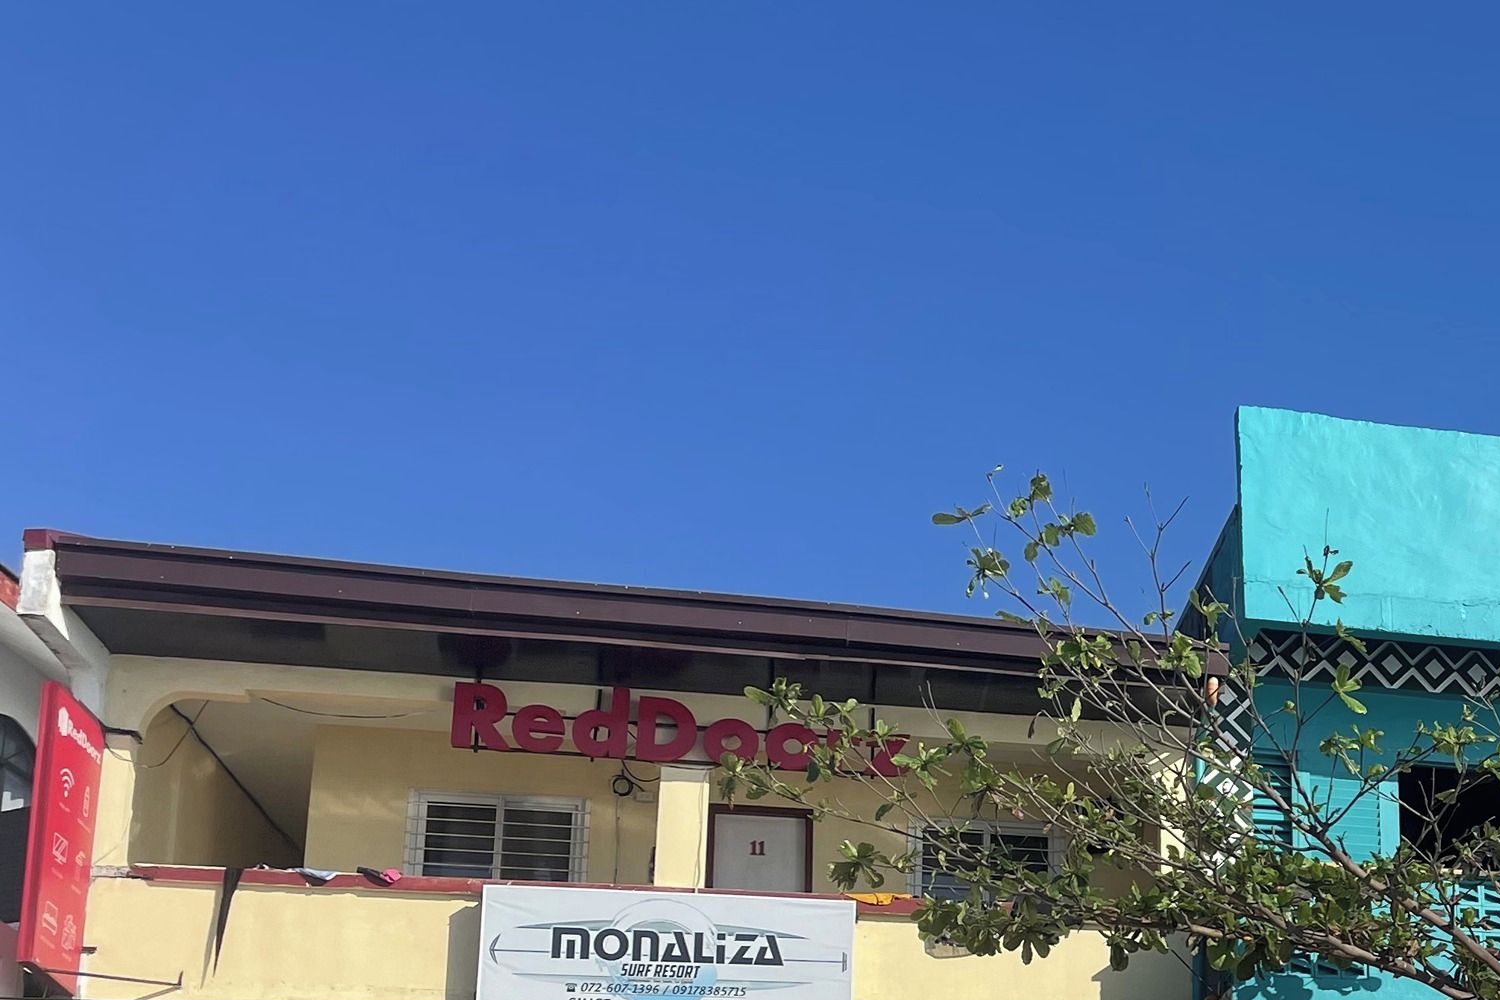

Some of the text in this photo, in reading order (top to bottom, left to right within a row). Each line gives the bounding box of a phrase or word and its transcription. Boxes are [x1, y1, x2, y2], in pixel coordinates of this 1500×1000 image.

[749, 839, 766, 856] 11
[621, 963, 701, 979] SURF RESORT
[580, 982, 660, 996] 072-607-1396
[672, 985, 747, 998] 09178385715
